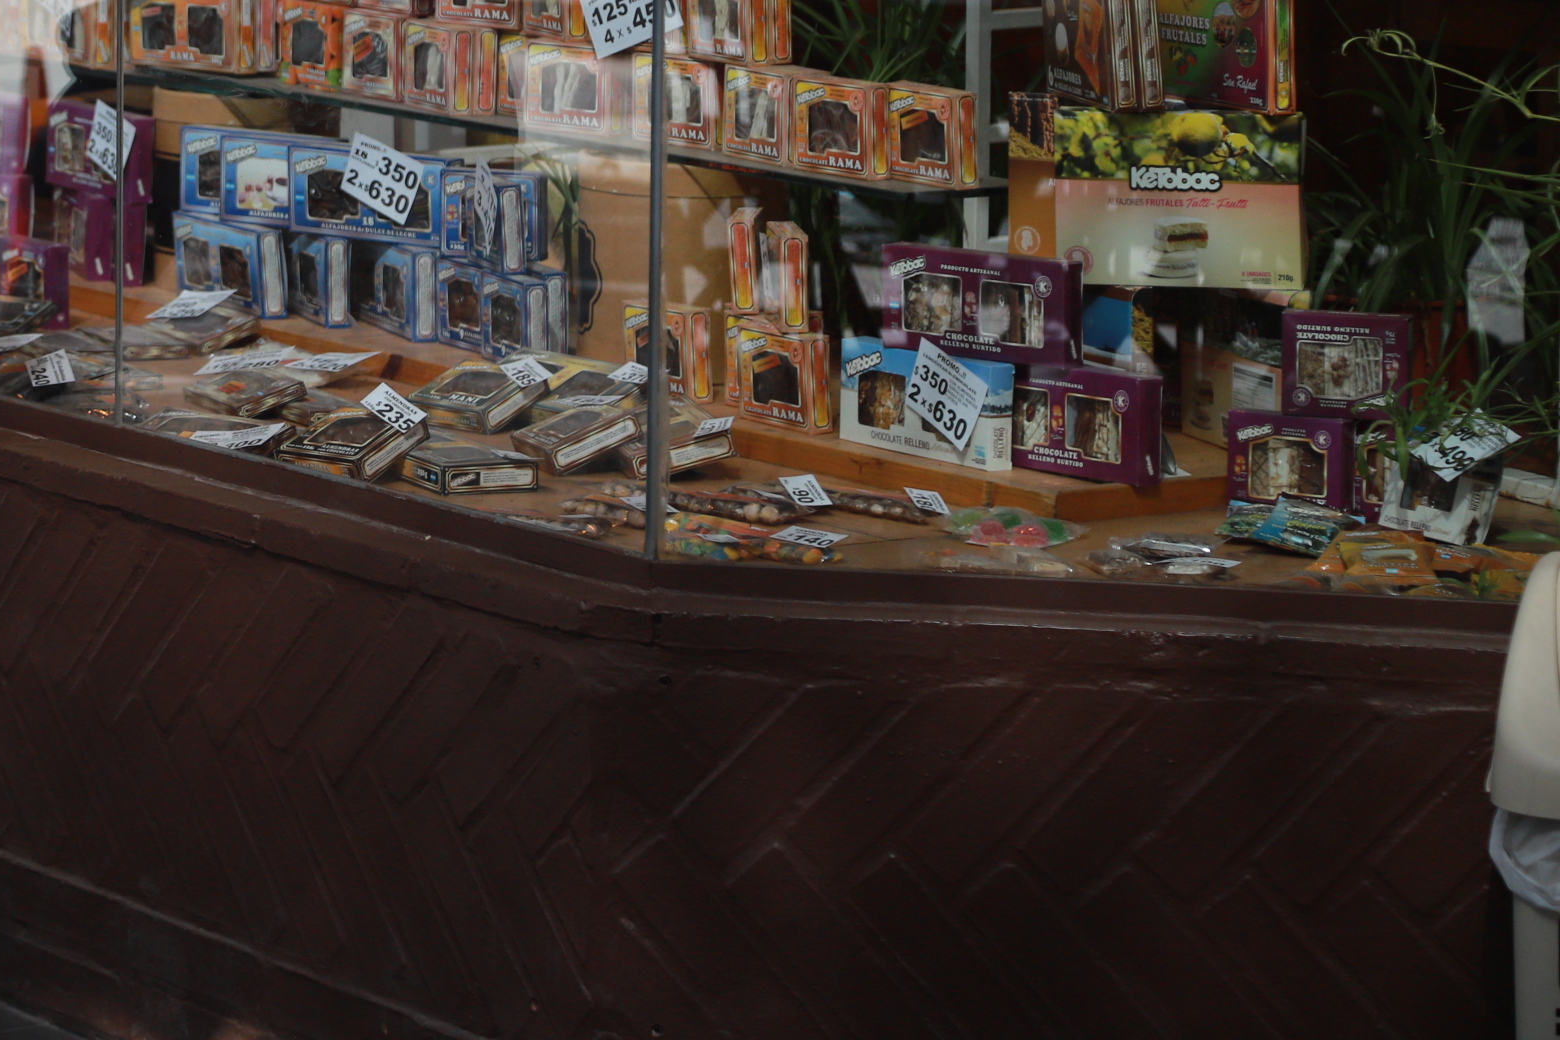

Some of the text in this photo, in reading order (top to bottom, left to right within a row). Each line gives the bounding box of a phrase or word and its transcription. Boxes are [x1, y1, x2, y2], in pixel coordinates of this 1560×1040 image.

[473, 8, 509, 21] RAMA
[1159, 11, 1211, 30] ALFAJORES
[542, 17, 562, 32] RAMA
[603, 28, 615, 44] 4
[1160, 29, 1208, 46] FRUTALES
[169, 50, 195, 61] RAMA
[716, 43, 743, 57] RAMA
[1047, 65, 1082, 87] 6 ALFAJORES
[1222, 72, 1259, 92] San Rafael
[426, 92, 447, 106] RAMA
[796, 86, 826, 105] KeTobac
[890, 94, 915, 112] KeTobac
[562, 114, 600, 127] RAMA
[671, 126, 705, 141] RAMA
[226, 144, 257, 163] KeTobac
[355, 148, 368, 159] 18
[751, 142, 779, 157] RAMA
[294, 155, 328, 174] KeTobac
[799, 155, 862, 171] CHOCOLATE RAMA
[346, 169, 358, 186] 2
[919, 164, 950, 181] RAMA
[1130, 166, 1221, 192] KeTobac
[1107, 196, 1184, 208] ALFAJORES FRUTALES
[321, 222, 357, 232] ALFAJORES
[361, 215, 374, 226] 18
[940, 263, 1001, 276] PRODUCTO ARTESANAL
[945, 331, 995, 346] CHOCOLATE
[1296, 332, 1349, 342] CHOCOLATE
[939, 339, 1002, 354] RELLENO SURTIDO
[845, 351, 882, 377] KeTobac
[914, 364, 948, 396] $350
[1055, 381, 1083, 390] ARTESANAL
[908, 383, 921, 403] 2
[384, 390, 418, 415] ALMENDRAS
[375, 400, 416, 431] $235
[772, 406, 804, 423] RAMA
[871, 430, 930, 451] CHOCOLATE RELLENO
[1236, 423, 1275, 442] KeTobac
[321, 444, 360, 453] ALMENDRAS
[1033, 446, 1079, 460] CHOCOLATE
[1027, 454, 1084, 468] RELLENO SURTIDO
